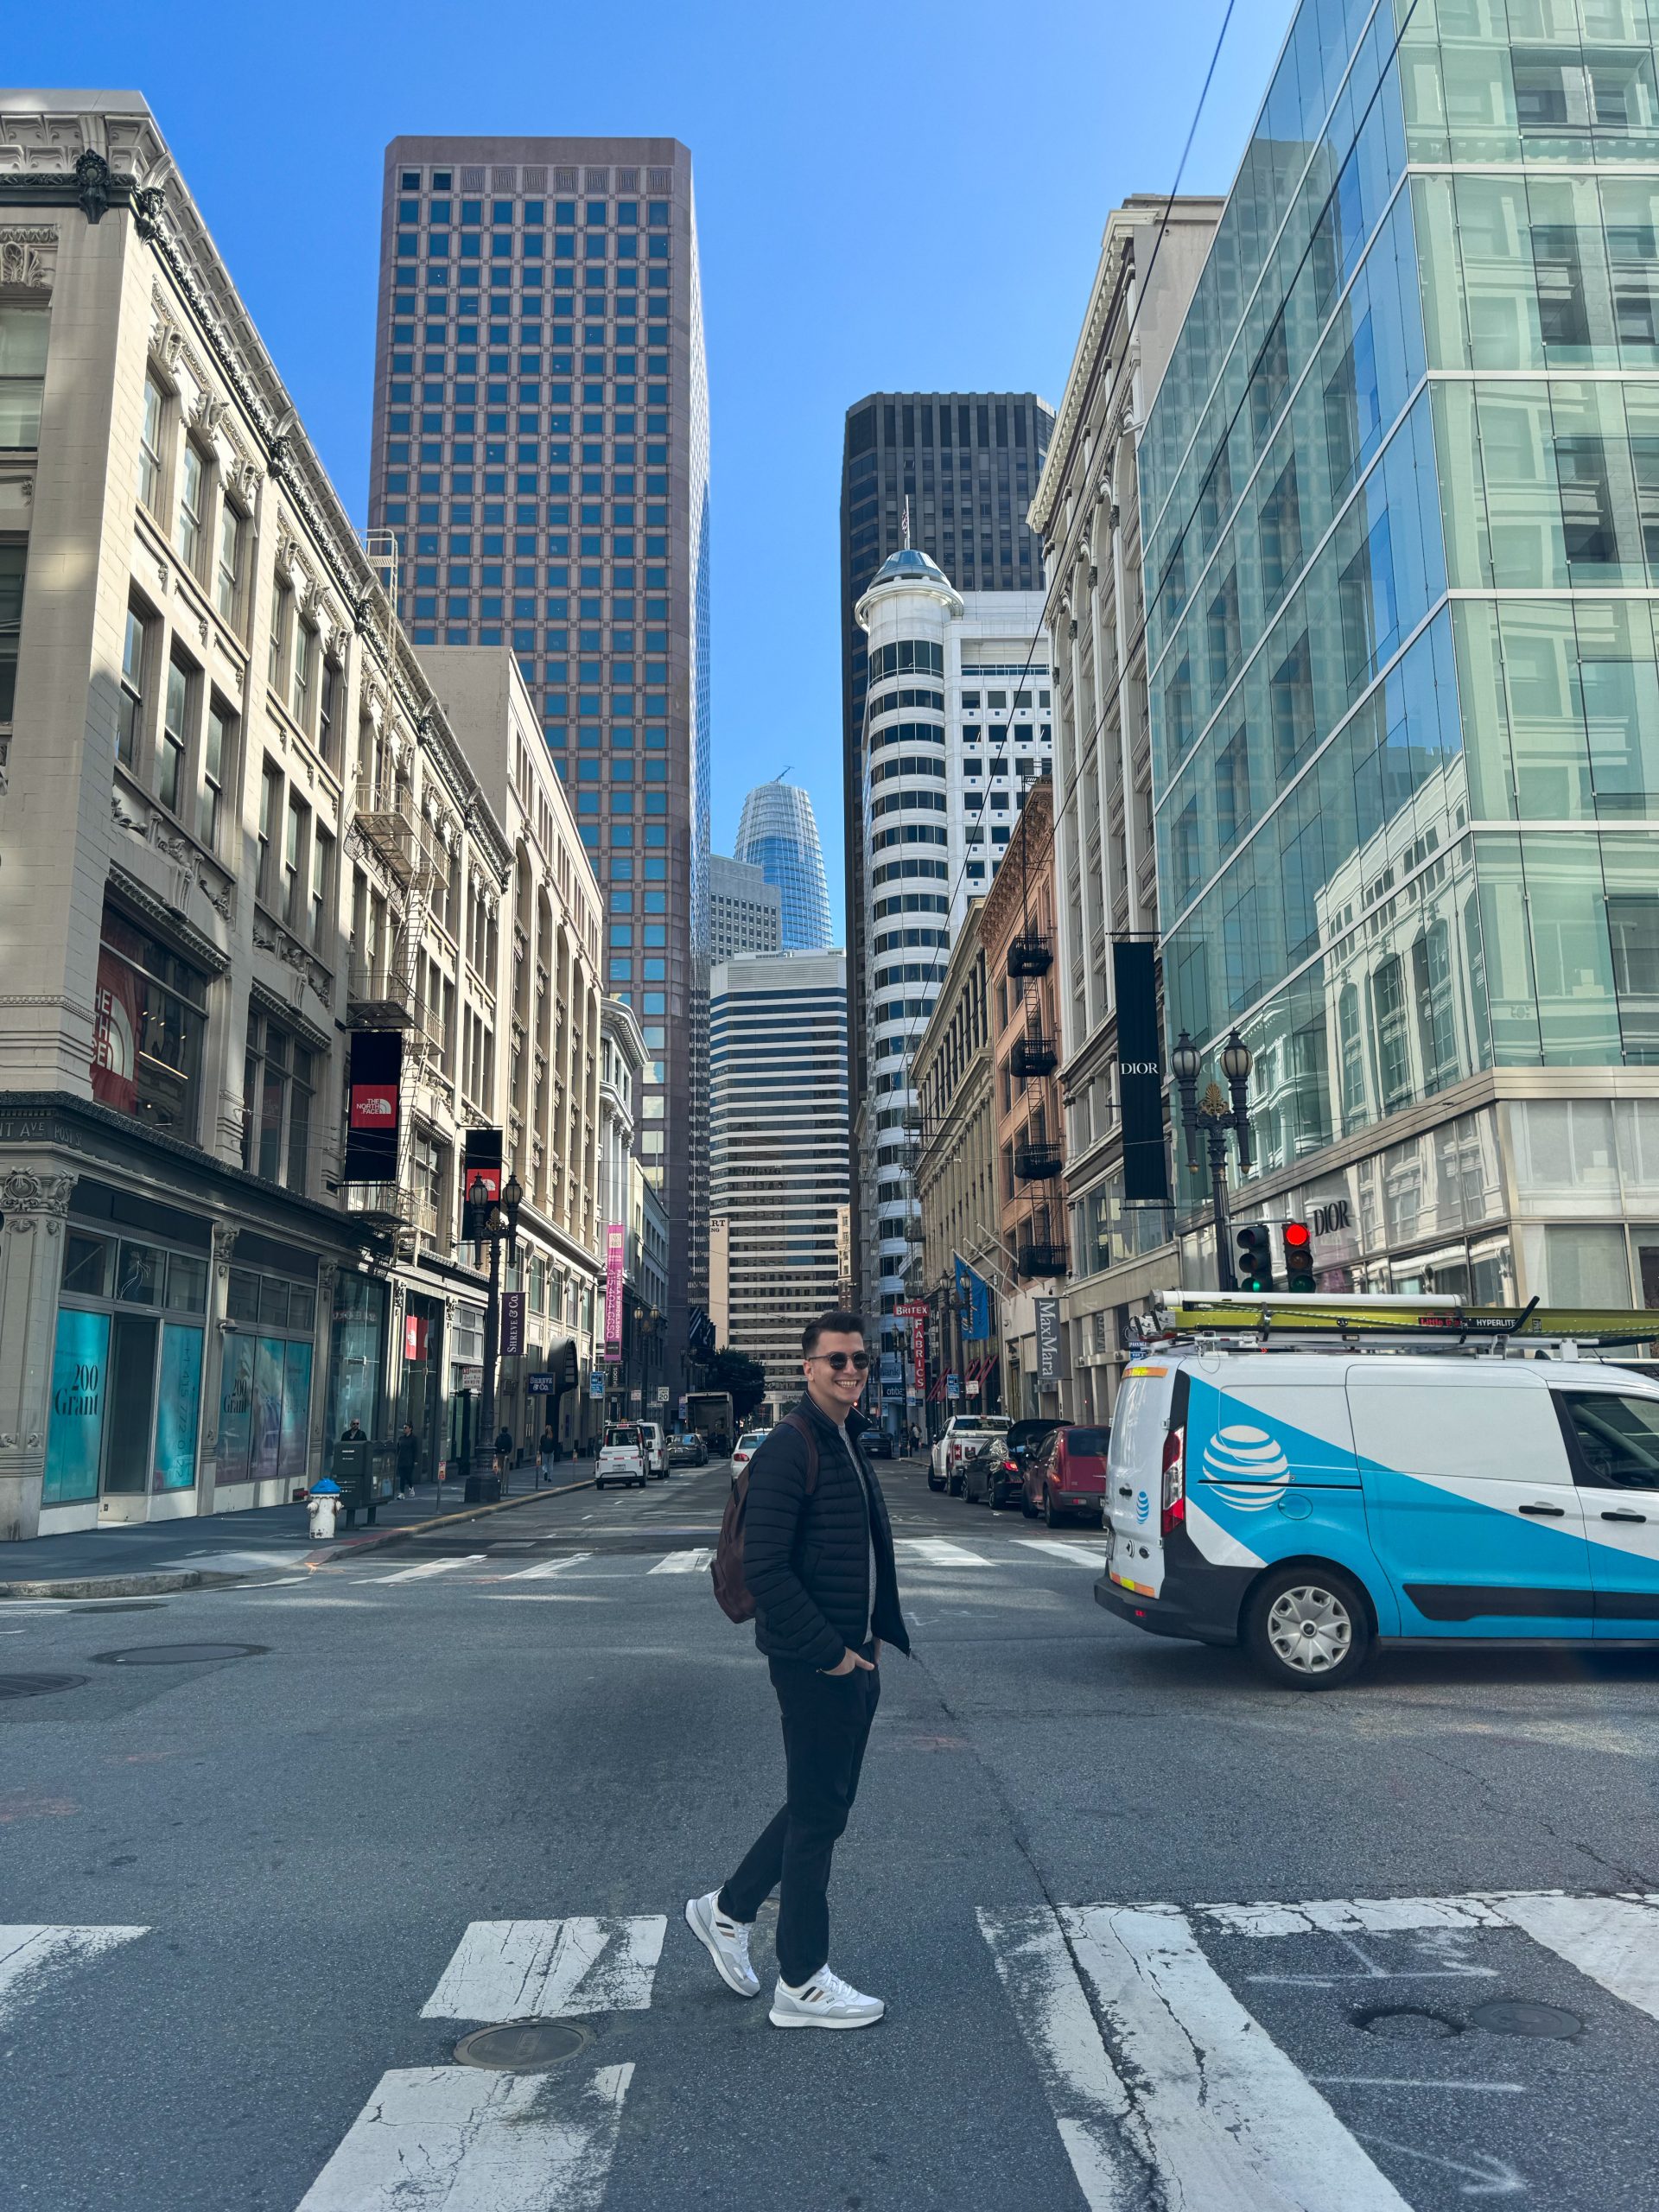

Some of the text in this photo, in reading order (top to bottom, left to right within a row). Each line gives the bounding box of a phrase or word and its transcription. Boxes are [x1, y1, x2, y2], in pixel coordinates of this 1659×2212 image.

[1121, 1063, 1159, 1074] DIOR
[54, 1124, 73, 1144] POST
[1313, 1200, 1351, 1237] DIOR
[508, 1309, 518, 1319] &
[896, 1306, 928, 1315] BRITEX
[1421, 1318, 1443, 1326] Little
[1476, 1319, 1516, 1327] HYPERLITE
[507, 1319, 518, 1353] SHREVE
[1039, 1300, 1058, 1376] MaxMara
[915, 1319, 925, 1387] FABRICS
[72, 1363, 99, 1392] 200
[232, 1377, 247, 1397] 200
[54, 1389, 99, 1416] Grant
[223, 1394, 247, 1414] Grant
